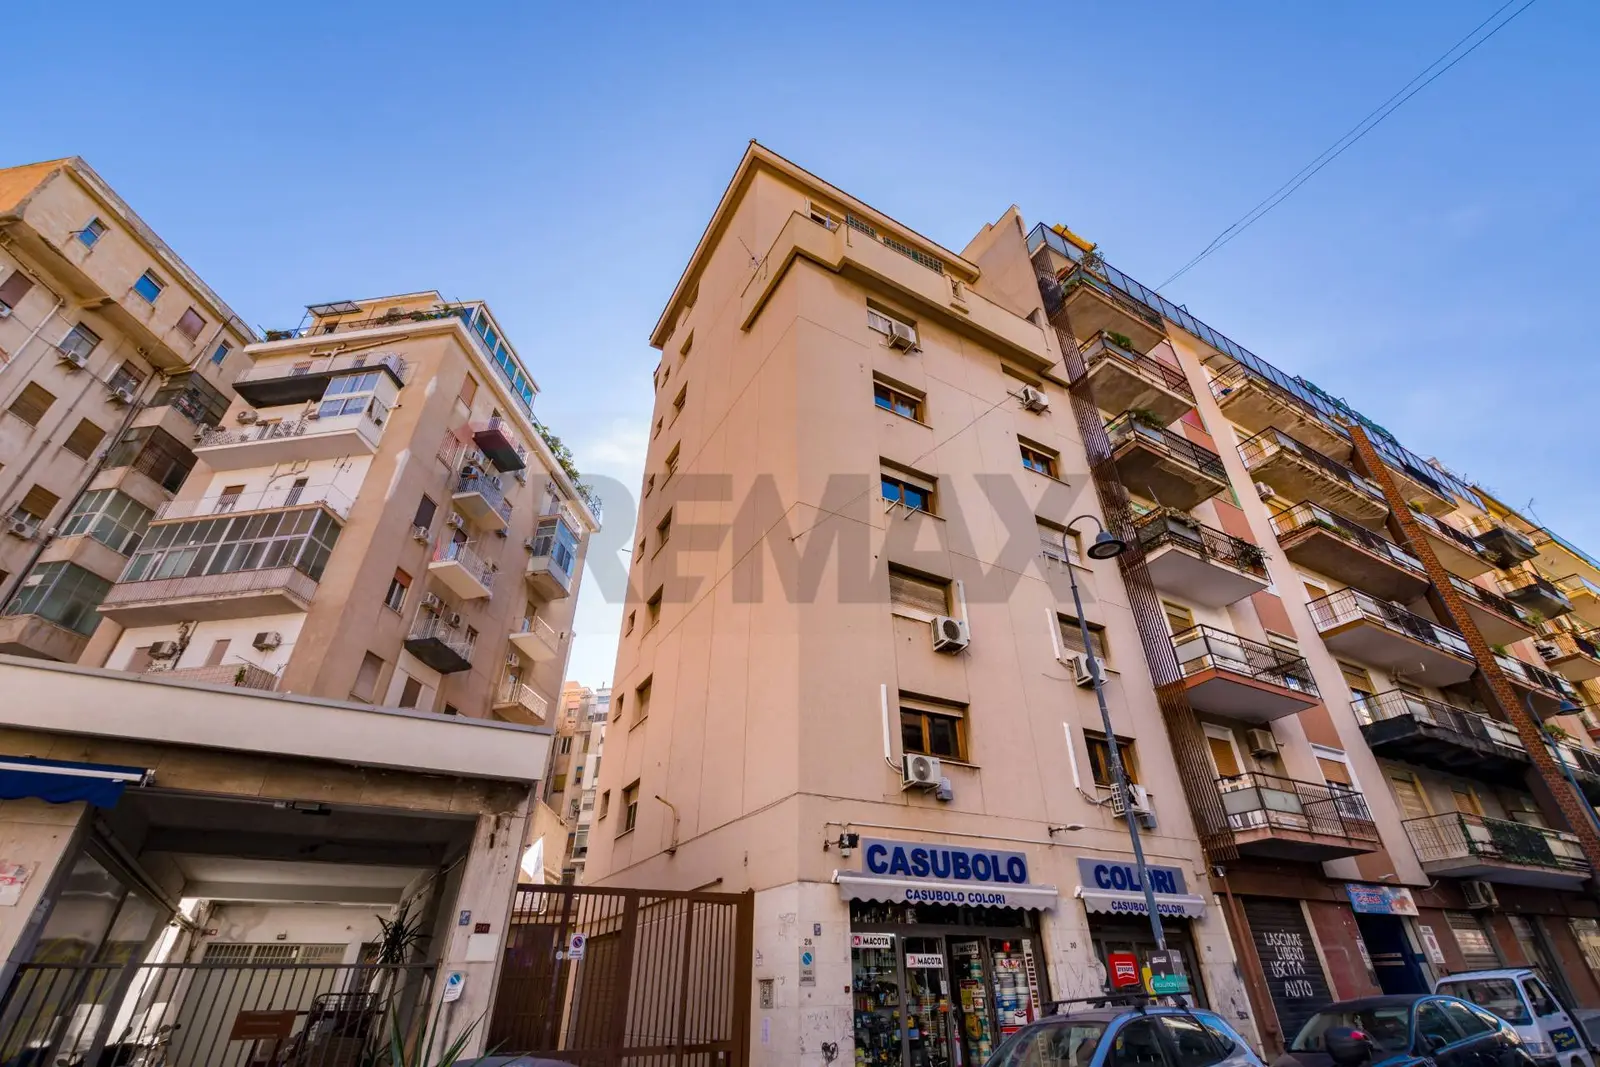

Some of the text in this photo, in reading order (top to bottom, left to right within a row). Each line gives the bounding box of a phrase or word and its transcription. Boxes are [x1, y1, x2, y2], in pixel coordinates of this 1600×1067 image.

[866, 844, 1027, 884] CASUBOLO
[905, 889, 1006, 905] CASUBOLO COLORI
[1111, 900, 1185, 914] CASUBOL COLORI
[863, 937, 890, 946] MACOTA
[1264, 931, 1303, 947] LASCIARE
[917, 957, 942, 965] MACOTA
[1275, 946, 1305, 961] LIBERO
[1270, 961, 1305, 978] USCITA
[1285, 979, 1313, 998] AUTO
